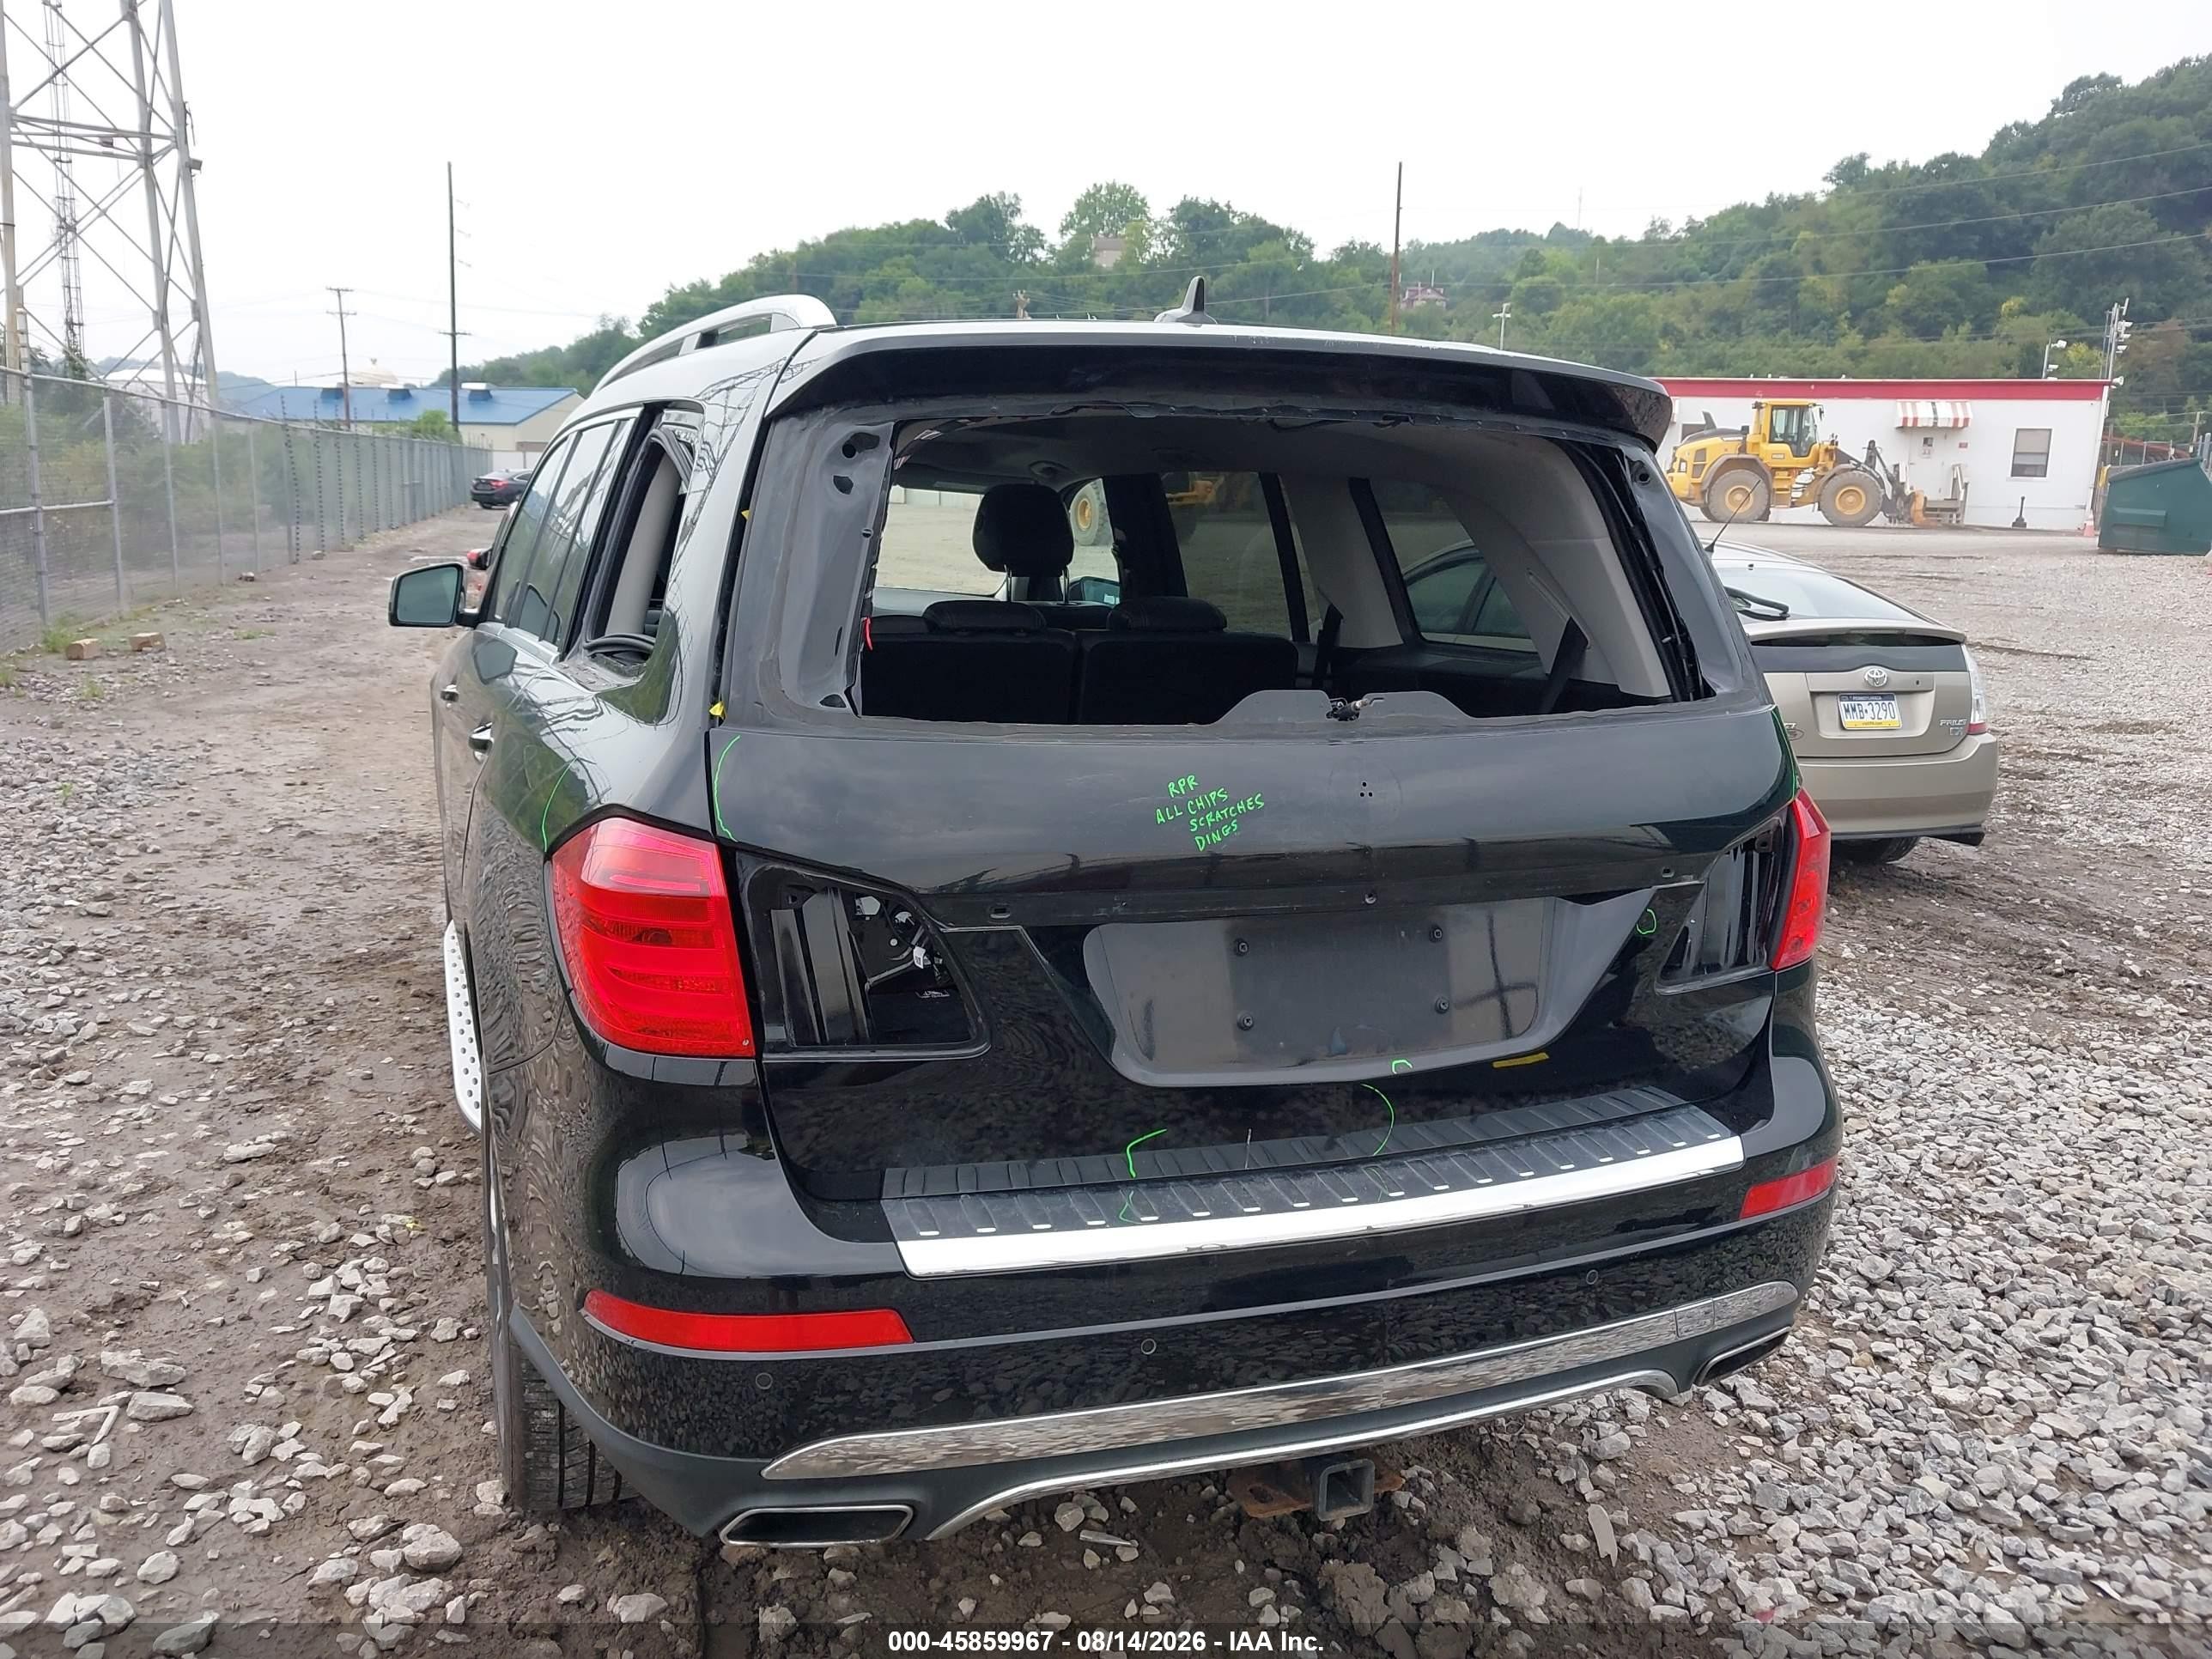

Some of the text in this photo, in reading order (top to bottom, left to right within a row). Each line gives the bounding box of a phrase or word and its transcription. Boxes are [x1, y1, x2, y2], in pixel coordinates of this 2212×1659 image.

[1168, 775, 1200, 798] RPR
[1156, 787, 1229, 824] ALL CHIPS
[1189, 793, 1265, 832] SCRATCHES
[1194, 819, 1237, 851] DINGS
